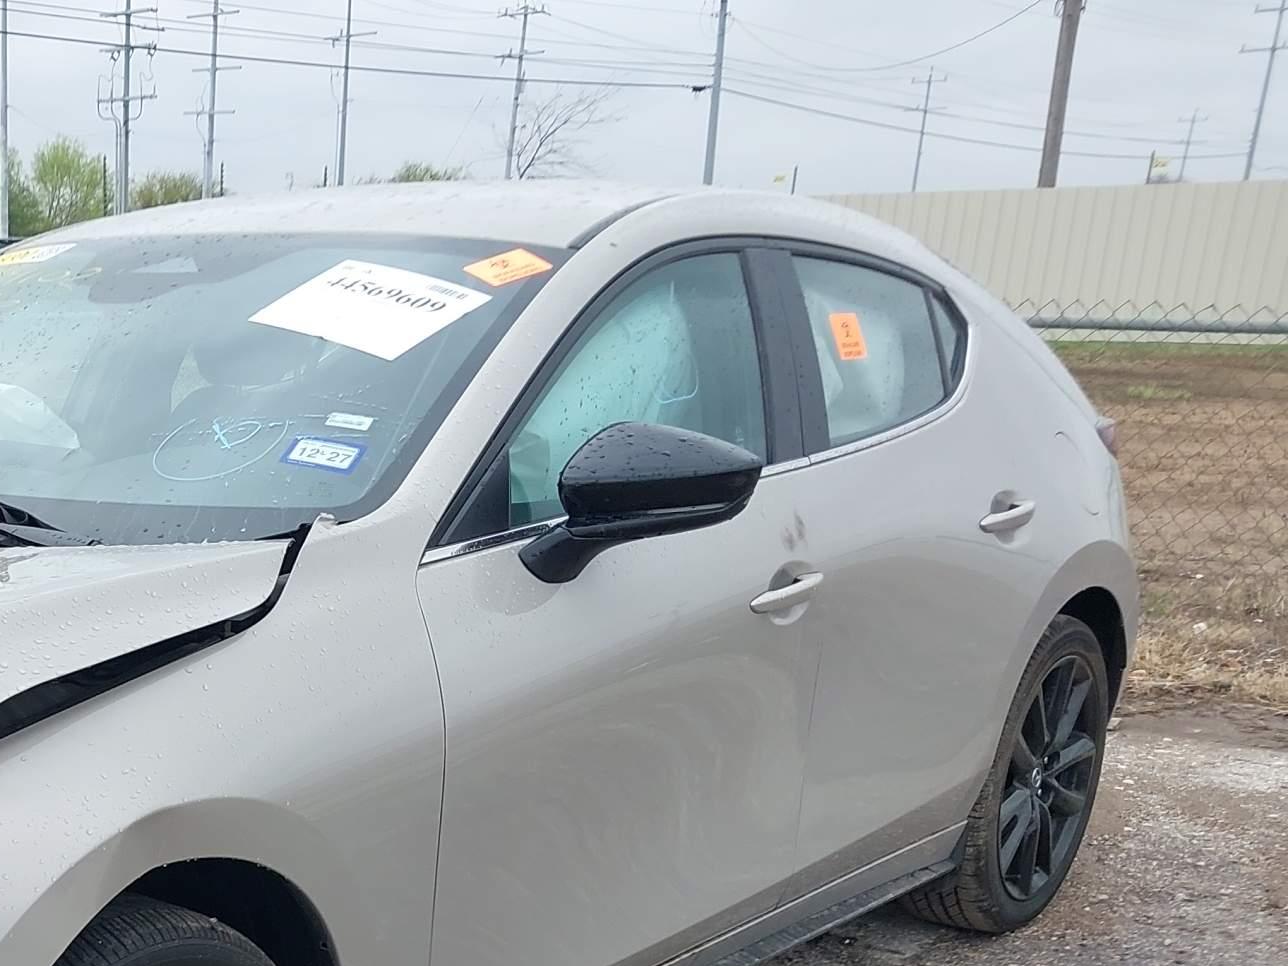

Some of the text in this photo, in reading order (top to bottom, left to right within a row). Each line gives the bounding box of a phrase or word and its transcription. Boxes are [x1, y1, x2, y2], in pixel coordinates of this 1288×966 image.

[327, 277, 447, 312] 44569609
[299, 447, 320, 458] 12
[326, 451, 353, 463] 27
